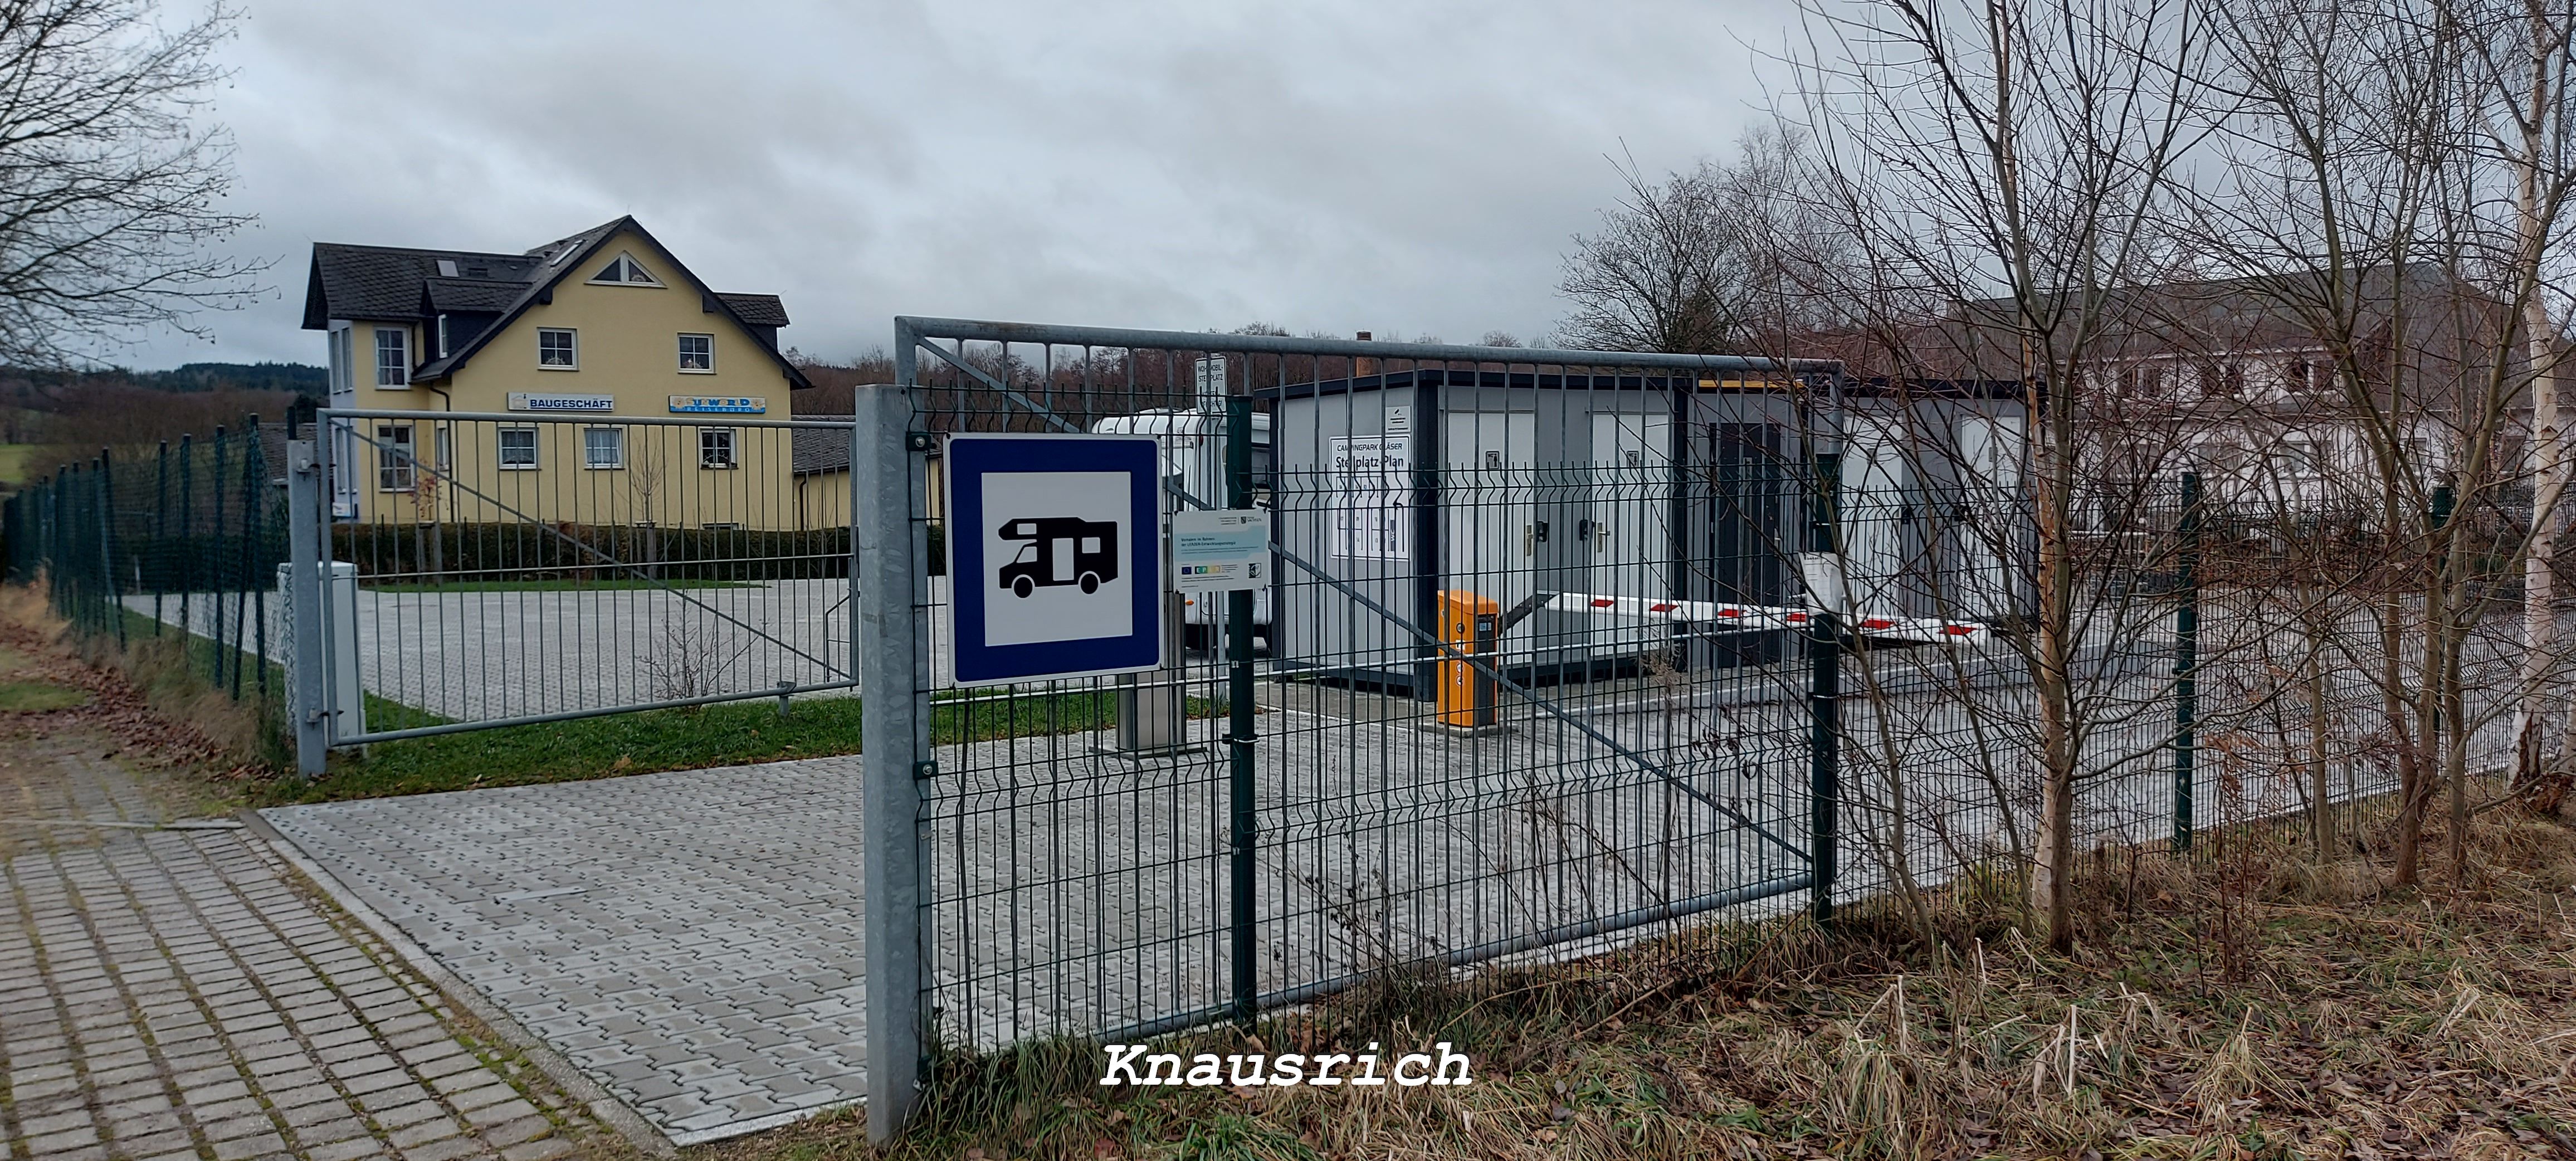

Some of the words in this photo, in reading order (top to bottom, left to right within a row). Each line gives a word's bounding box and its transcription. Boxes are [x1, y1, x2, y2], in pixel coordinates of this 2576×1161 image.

[530, 398, 613, 408] BAUGESCHÄFT
[1337, 443, 1378, 452] CAMINGPARK
[1379, 442, 1403, 451] GÄSER
